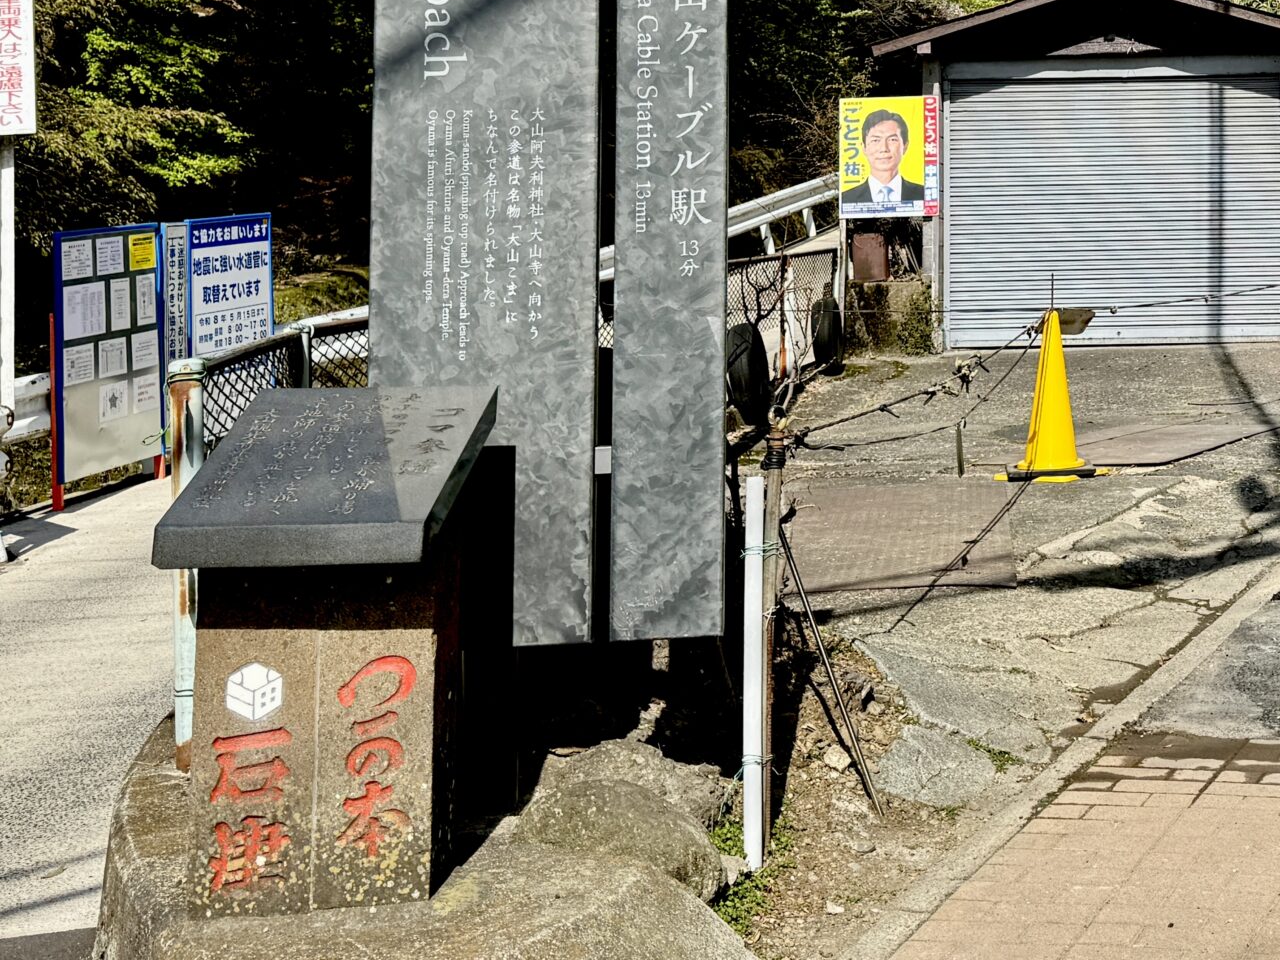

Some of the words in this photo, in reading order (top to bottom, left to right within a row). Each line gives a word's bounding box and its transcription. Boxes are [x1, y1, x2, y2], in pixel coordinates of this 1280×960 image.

[636, 15, 661, 80] Cable
[426, 109, 438, 146] Oyama
[443, 109, 456, 146] Oyama
[635, 86, 660, 170] Station
[843, 107, 862, 183] ごとう祐一
[427, 150, 438, 158] is
[427, 161, 439, 197] famous
[444, 179, 455, 213] Shrine
[426, 218, 436, 230] its
[427, 201, 438, 214] for
[443, 216, 454, 233] and
[483, 107, 499, 308] ちなんで名付けられました。
[503, 109, 523, 322] この参道は名物「大山こま」に
[527, 107, 546, 340] 大山阿夫利神社・大山寺へ向かう
[192, 223, 268, 244] ご協力をお願いします
[192, 251, 268, 277] 地震に強い水道管に
[423, 234, 436, 277] spinning
[679, 239, 700, 277] 13分
[202, 278, 261, 305] 取替えています
[458, 271, 470, 319] Approach
[458, 323, 470, 348] leads
[458, 350, 466, 361] to
